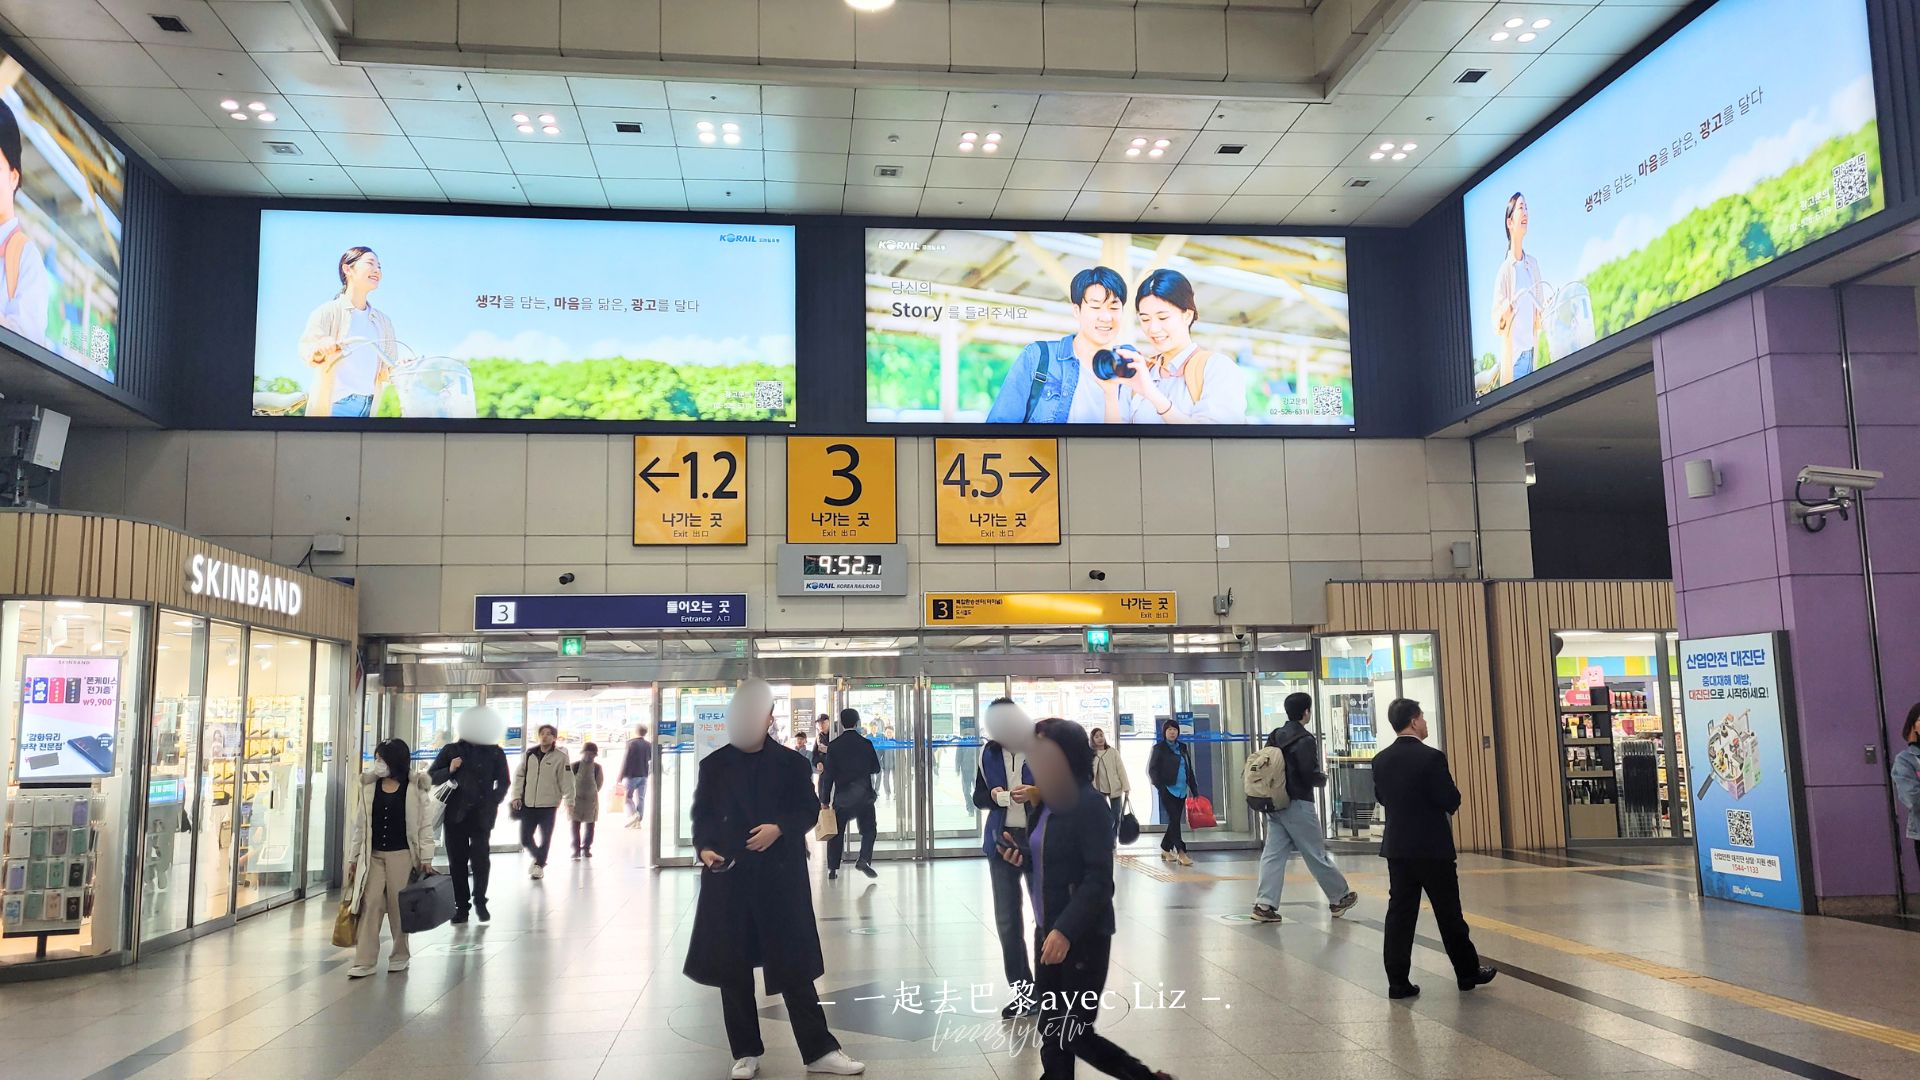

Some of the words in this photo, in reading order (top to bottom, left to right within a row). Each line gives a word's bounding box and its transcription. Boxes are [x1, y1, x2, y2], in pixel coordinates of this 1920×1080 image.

[1585, 184, 1611, 212] 생각을
[1615, 172, 1637, 194] 담는,
[1638, 147, 1669, 177] 마음을
[1672, 131, 1698, 158] 닮은,
[1700, 104, 1735, 139] 광고를
[1739, 85, 1763, 115] 달다
[720, 233, 757, 243] KORAIL
[878, 239, 920, 251] KORAIL
[891, 281, 932, 296] 당신의
[476, 295, 515, 309] 생각을
[521, 296, 550, 310] 담는,
[554, 297, 593, 311] 마음을
[599, 298, 627, 312] 닮은,
[631, 299, 669, 312] 광고를
[675, 300, 700, 313] 달다
[891, 301, 943, 322] Story
[949, 305, 960, 319] 를
[966, 305, 1028, 321] 들려주세요
[682, 450, 738, 500] 1.2
[823, 443, 863, 507] 3
[942, 452, 1004, 498] 4.5
[662, 512, 702, 528] 나가는
[709, 512, 723, 528] 곳
[811, 512, 850, 527] 나가는
[857, 512, 870, 527] 곳
[969, 512, 1008, 528] 나가는
[1015, 512, 1027, 528] 곳
[673, 530, 689, 538] Exit
[693, 530, 709, 538] 出口
[822, 529, 836, 537] Exit
[841, 529, 857, 537] 出口
[980, 530, 995, 538] Exit
[999, 530, 1014, 538] 出口
[190, 553, 302, 616] SKINBAND
[497, 604, 509, 622] 3
[666, 600, 713, 614] 들어오는
[719, 600, 730, 614] 곳
[937, 601, 949, 618] 3
[1120, 597, 1153, 610] 나가는
[1158, 597, 1169, 610] 곳
[681, 615, 711, 623] Entrance
[1686, 651, 1728, 669] 산업안전
[1730, 648, 1765, 666] 대진단
[1702, 675, 1732, 687] 중대재해
[1734, 673, 1752, 687] 예방,
[1688, 689, 1725, 700] 대진단으로
[1726, 687, 1769, 699] 시작하세요!
[1732, 864, 1759, 874] 1544-1133
